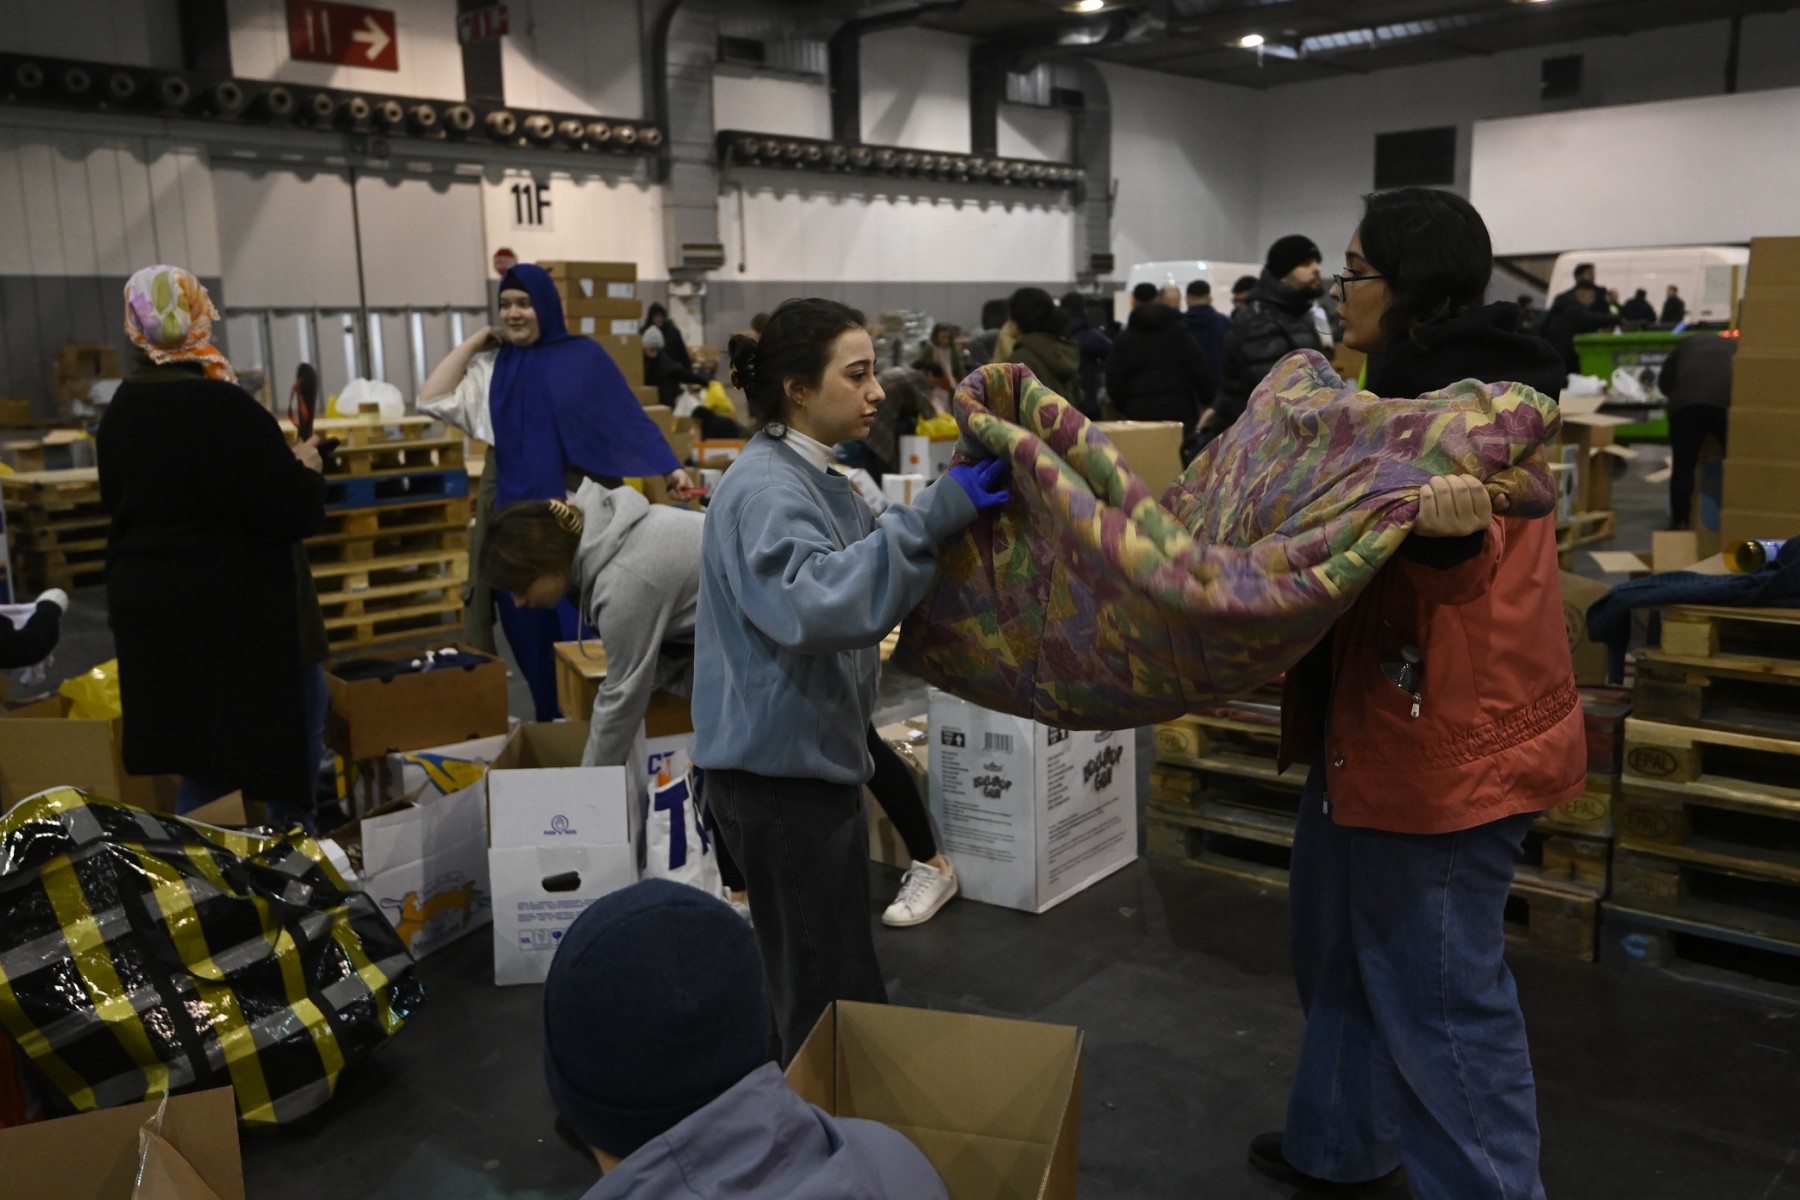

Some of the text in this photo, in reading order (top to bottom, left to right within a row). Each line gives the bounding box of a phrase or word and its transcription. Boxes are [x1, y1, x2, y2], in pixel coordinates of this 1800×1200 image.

[511, 184, 551, 225] 11F
[1634, 751, 1671, 772] EPAL
[1564, 799, 1599, 816] EPAL
